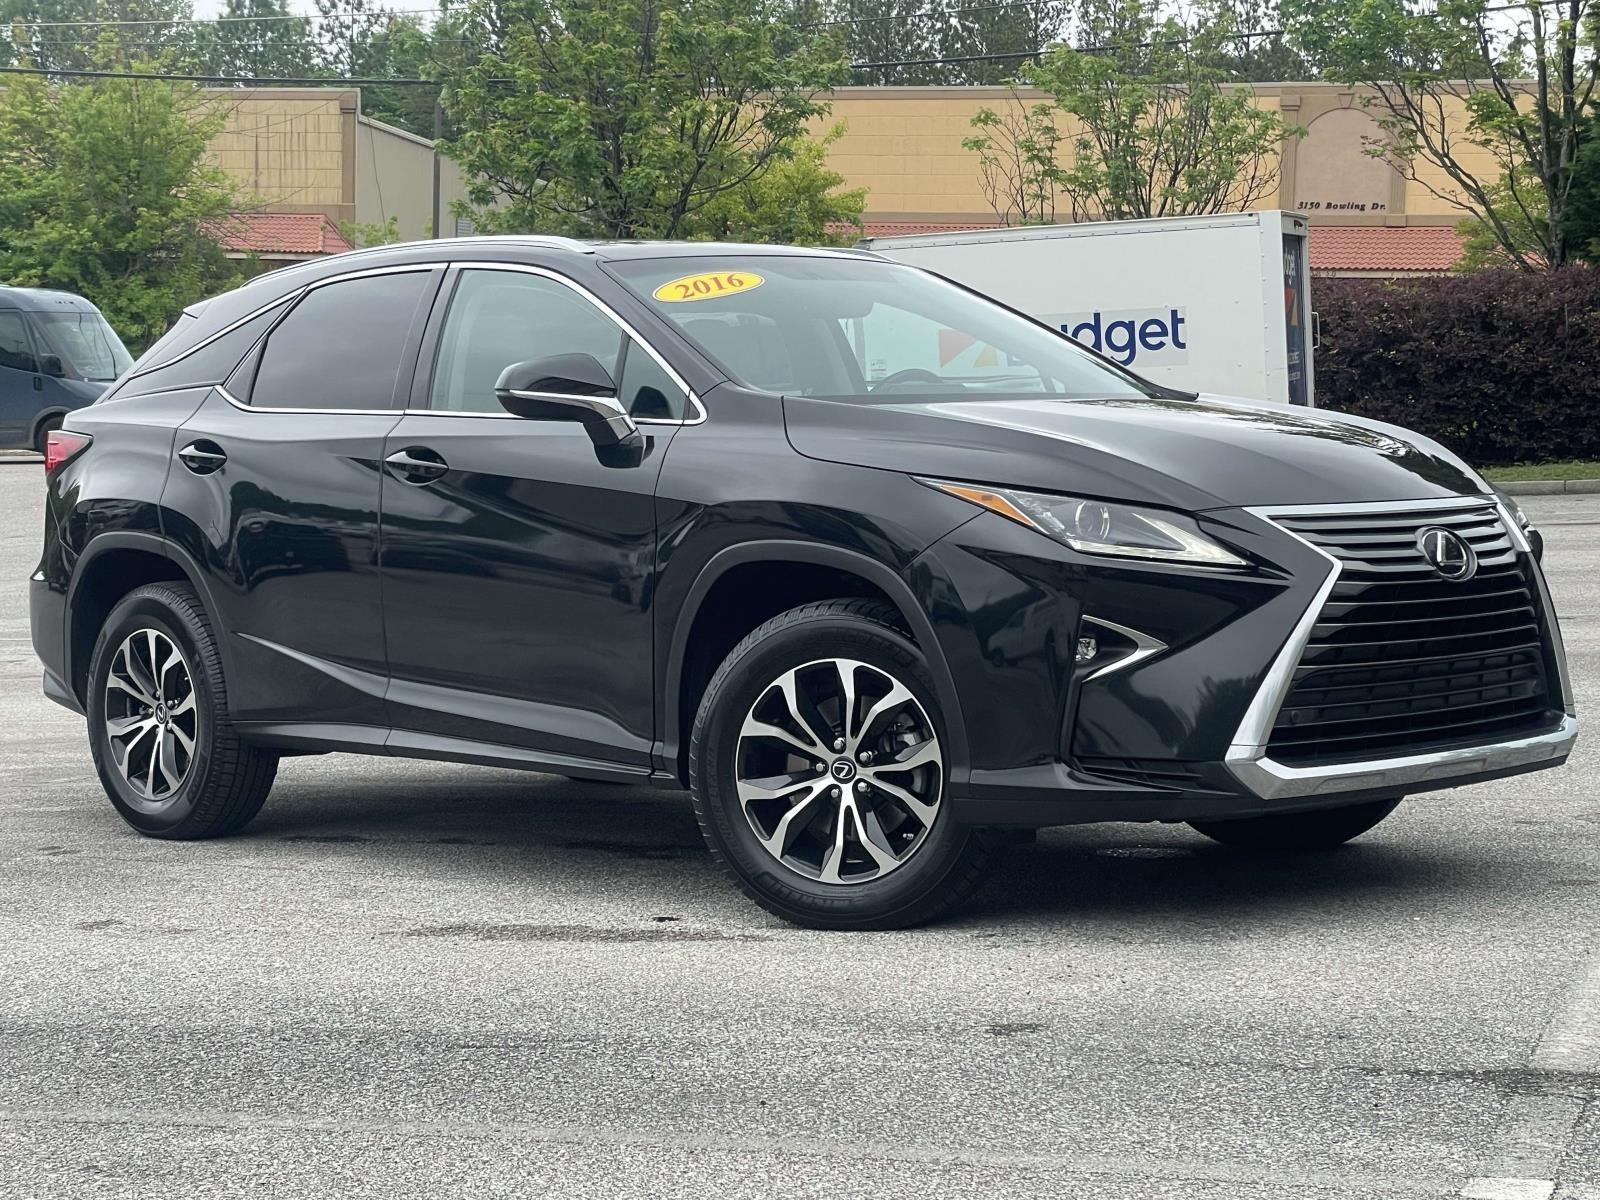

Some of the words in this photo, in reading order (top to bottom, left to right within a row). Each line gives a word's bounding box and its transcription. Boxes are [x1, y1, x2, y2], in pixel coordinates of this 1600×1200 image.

[1297, 201, 1321, 210] 3150
[1325, 201, 1366, 211] Bowling
[1370, 202, 1386, 210] Dr.
[674, 273, 745, 299] 2016
